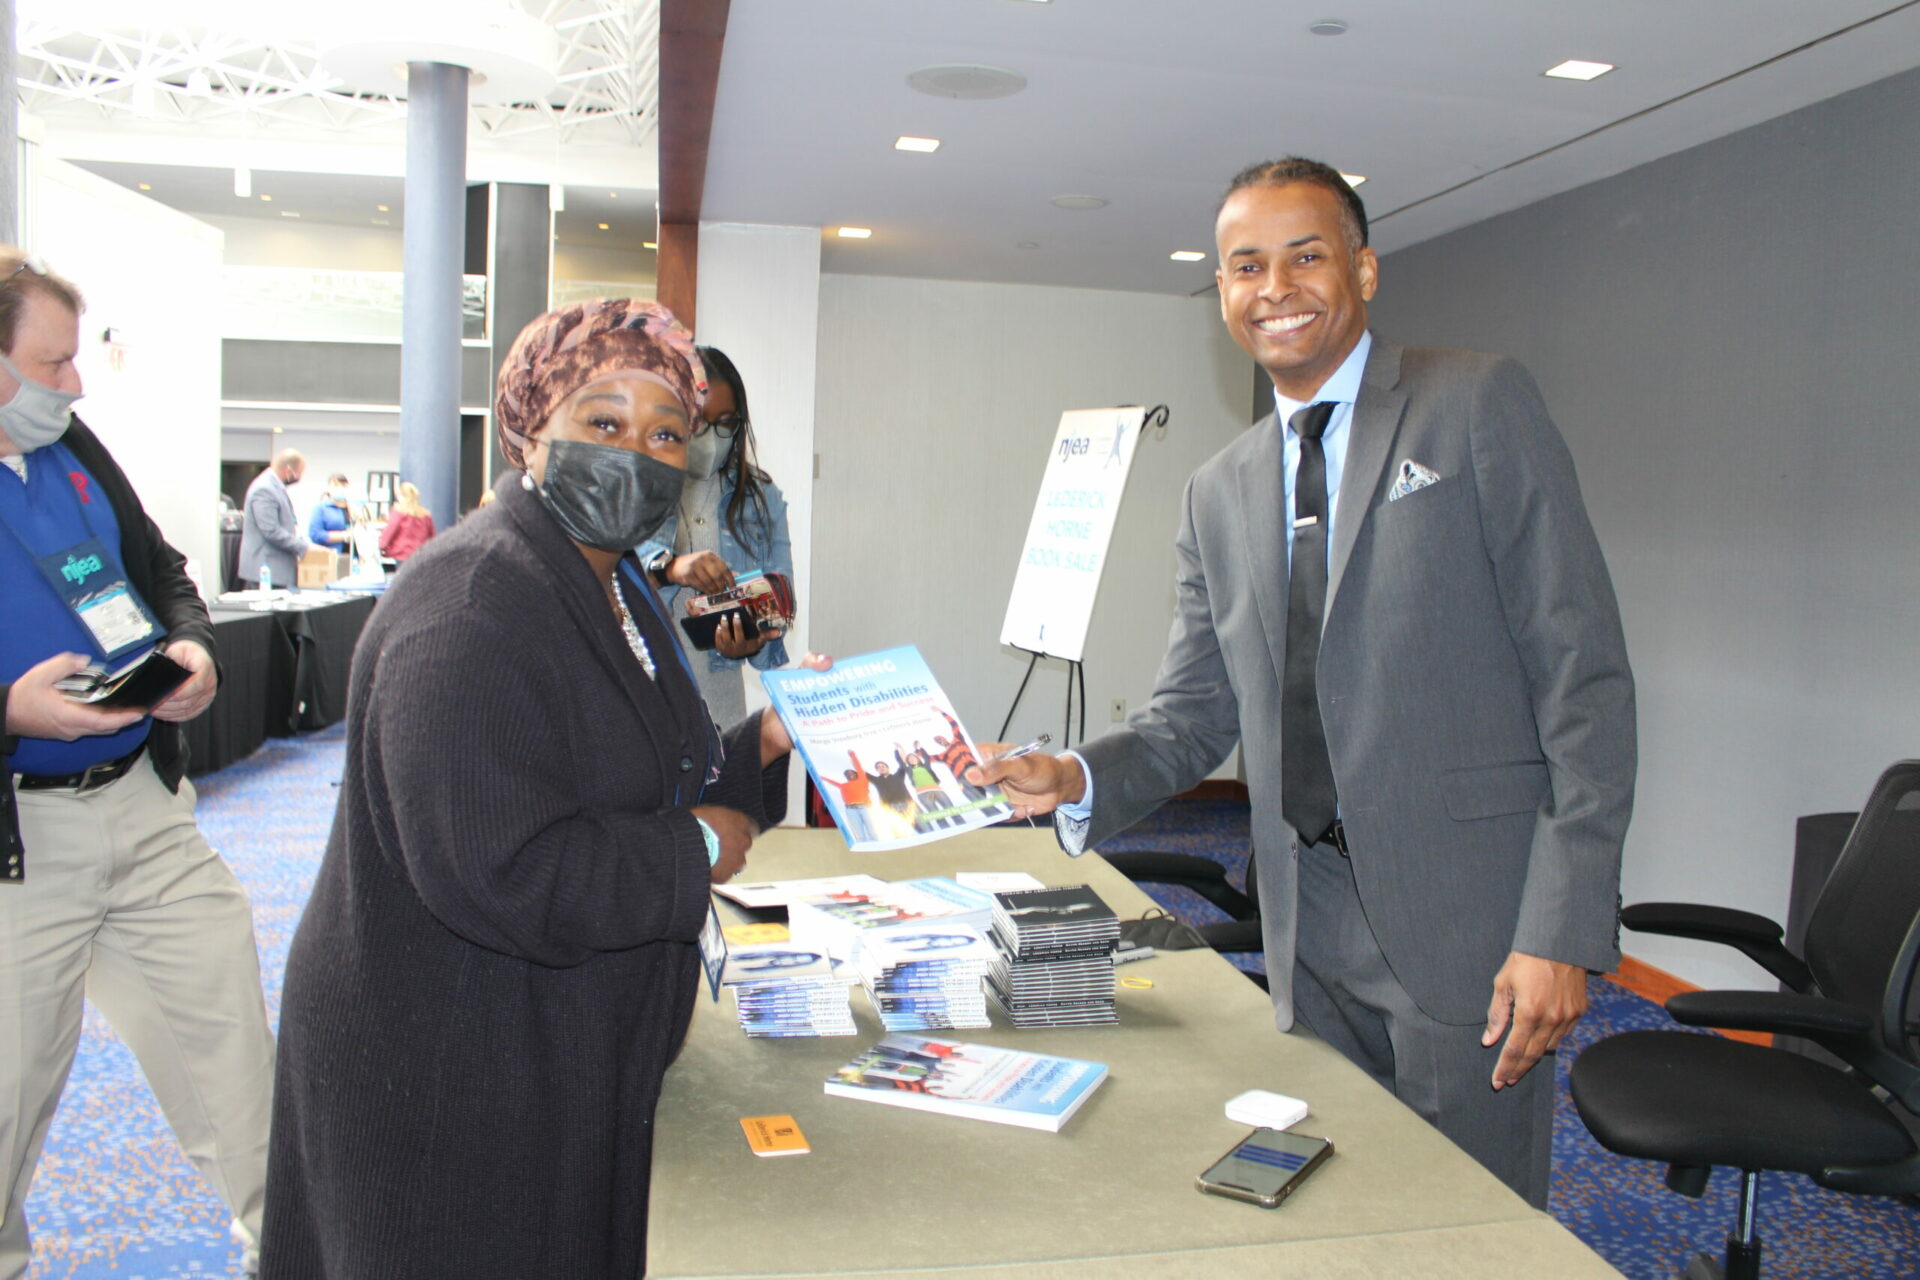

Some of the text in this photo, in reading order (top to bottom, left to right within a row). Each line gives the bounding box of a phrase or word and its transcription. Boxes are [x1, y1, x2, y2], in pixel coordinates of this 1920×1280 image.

[1058, 431, 1090, 463] njea
[1047, 490, 1107, 509] LEDERICK
[1046, 520, 1092, 540] HORNE
[60, 553, 104, 585] njea
[1025, 547, 1100, 572] BOOK SALE
[780, 659, 897, 693] EMPOWERING
[787, 680, 877, 706] Students with
[794, 684, 929, 718] Hidden Disabilities
